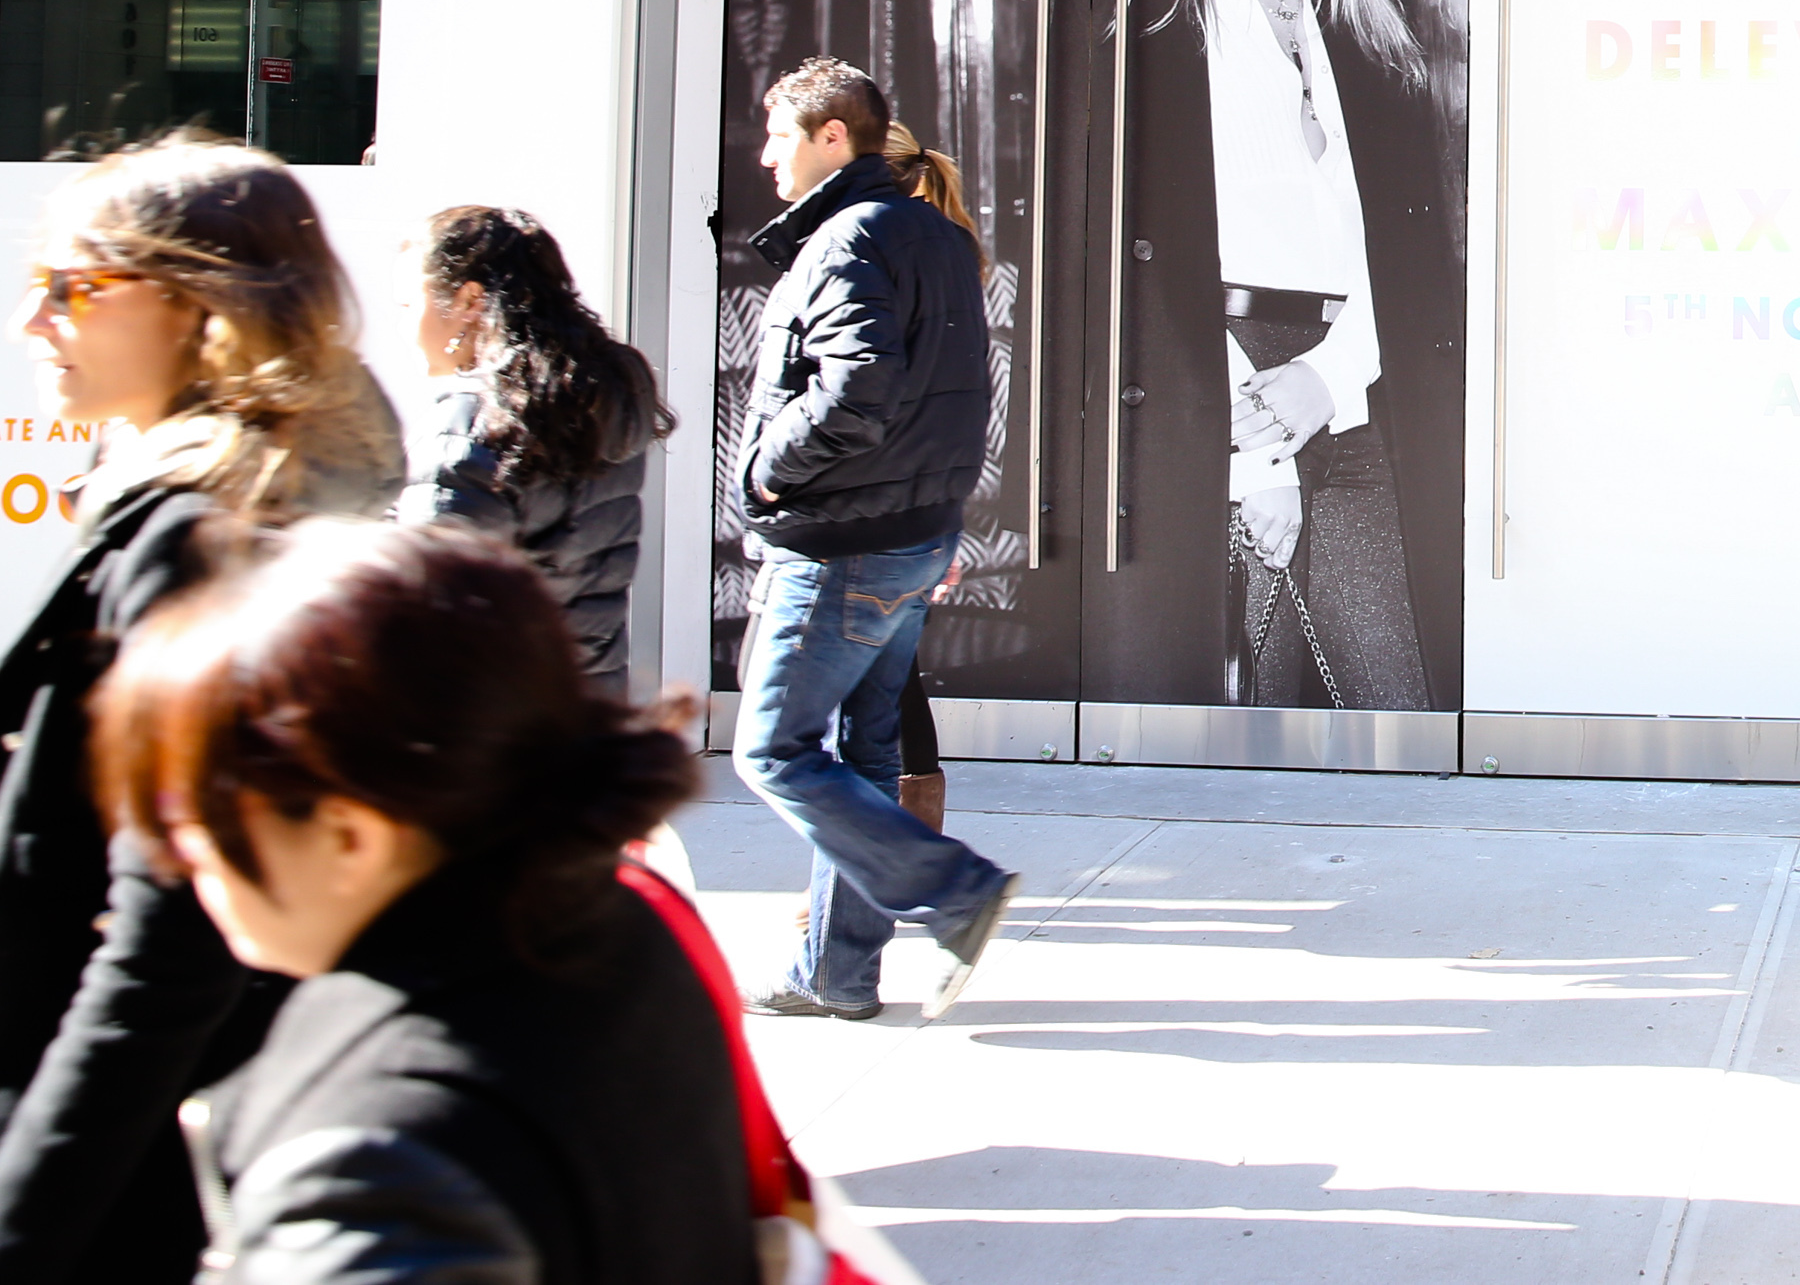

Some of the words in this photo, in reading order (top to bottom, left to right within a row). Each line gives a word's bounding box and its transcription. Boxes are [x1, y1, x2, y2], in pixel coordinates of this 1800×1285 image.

[1571, 187, 1792, 253] MAX
[1623, 292, 1707, 339] 5TH
[0, 418, 35, 442] TE
